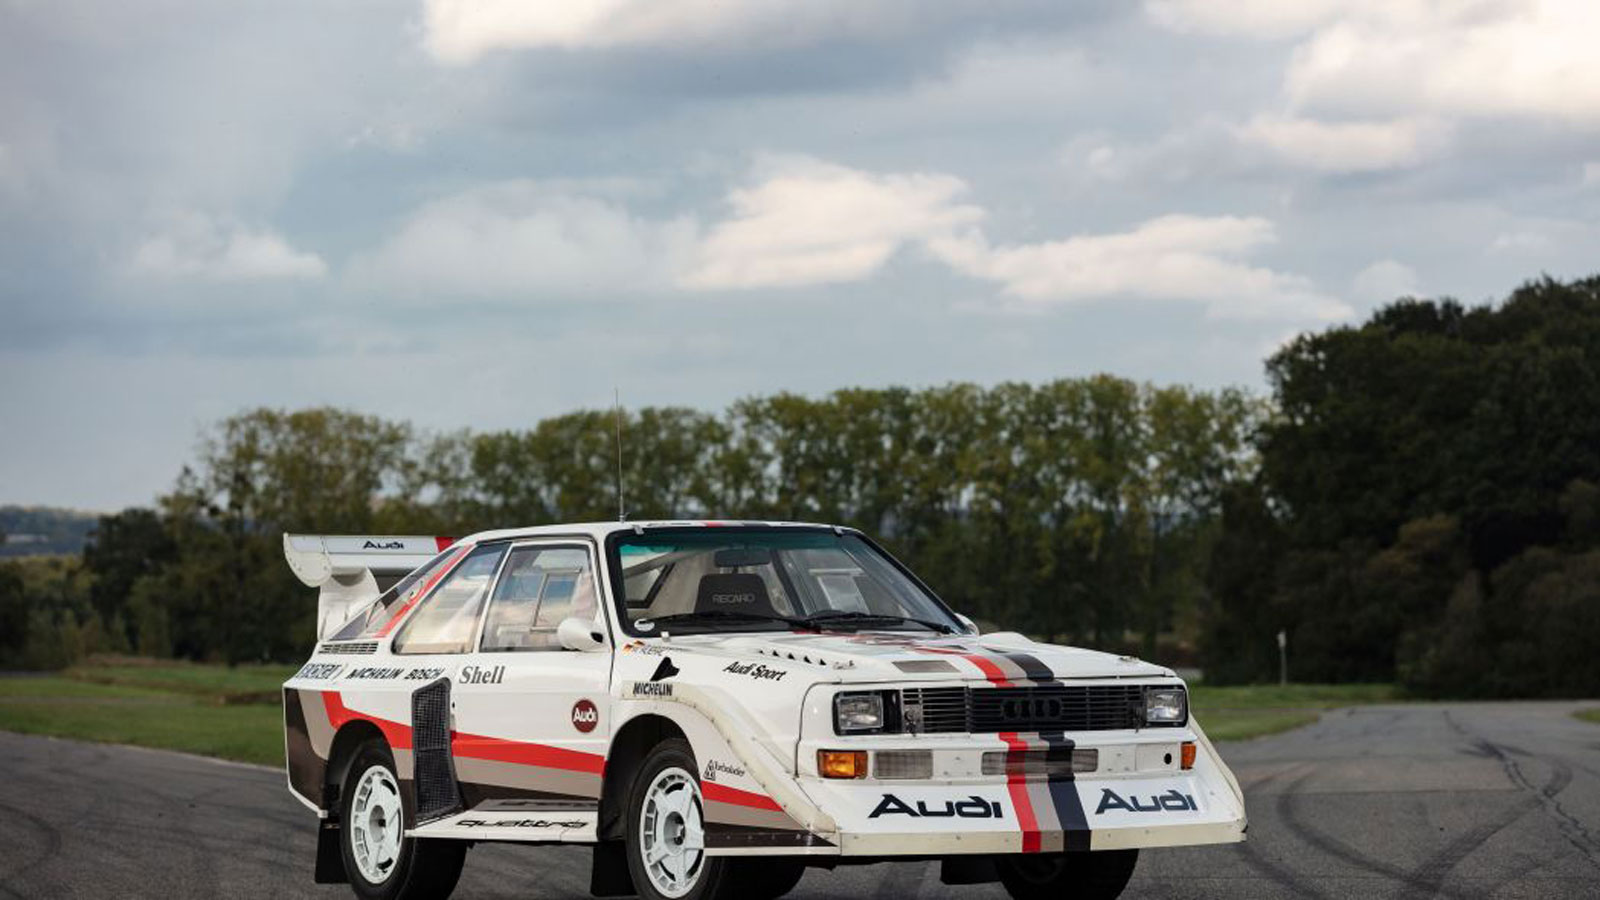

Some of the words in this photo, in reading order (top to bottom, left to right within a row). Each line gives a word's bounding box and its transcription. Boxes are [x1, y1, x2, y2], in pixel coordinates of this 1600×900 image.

[363, 540, 404, 549] Audi
[712, 593, 755, 603] RECARO
[345, 667, 403, 679] MICHELIN
[459, 665, 506, 684] Shell
[723, 661, 753, 675] Audi
[751, 664, 787, 681] Sport
[633, 682, 673, 696] MICHELIN
[573, 708, 597, 723] Audi
[868, 794, 1003, 818] Audi
[1095, 788, 1198, 815] Audi
[456, 819, 589, 828] quattro
